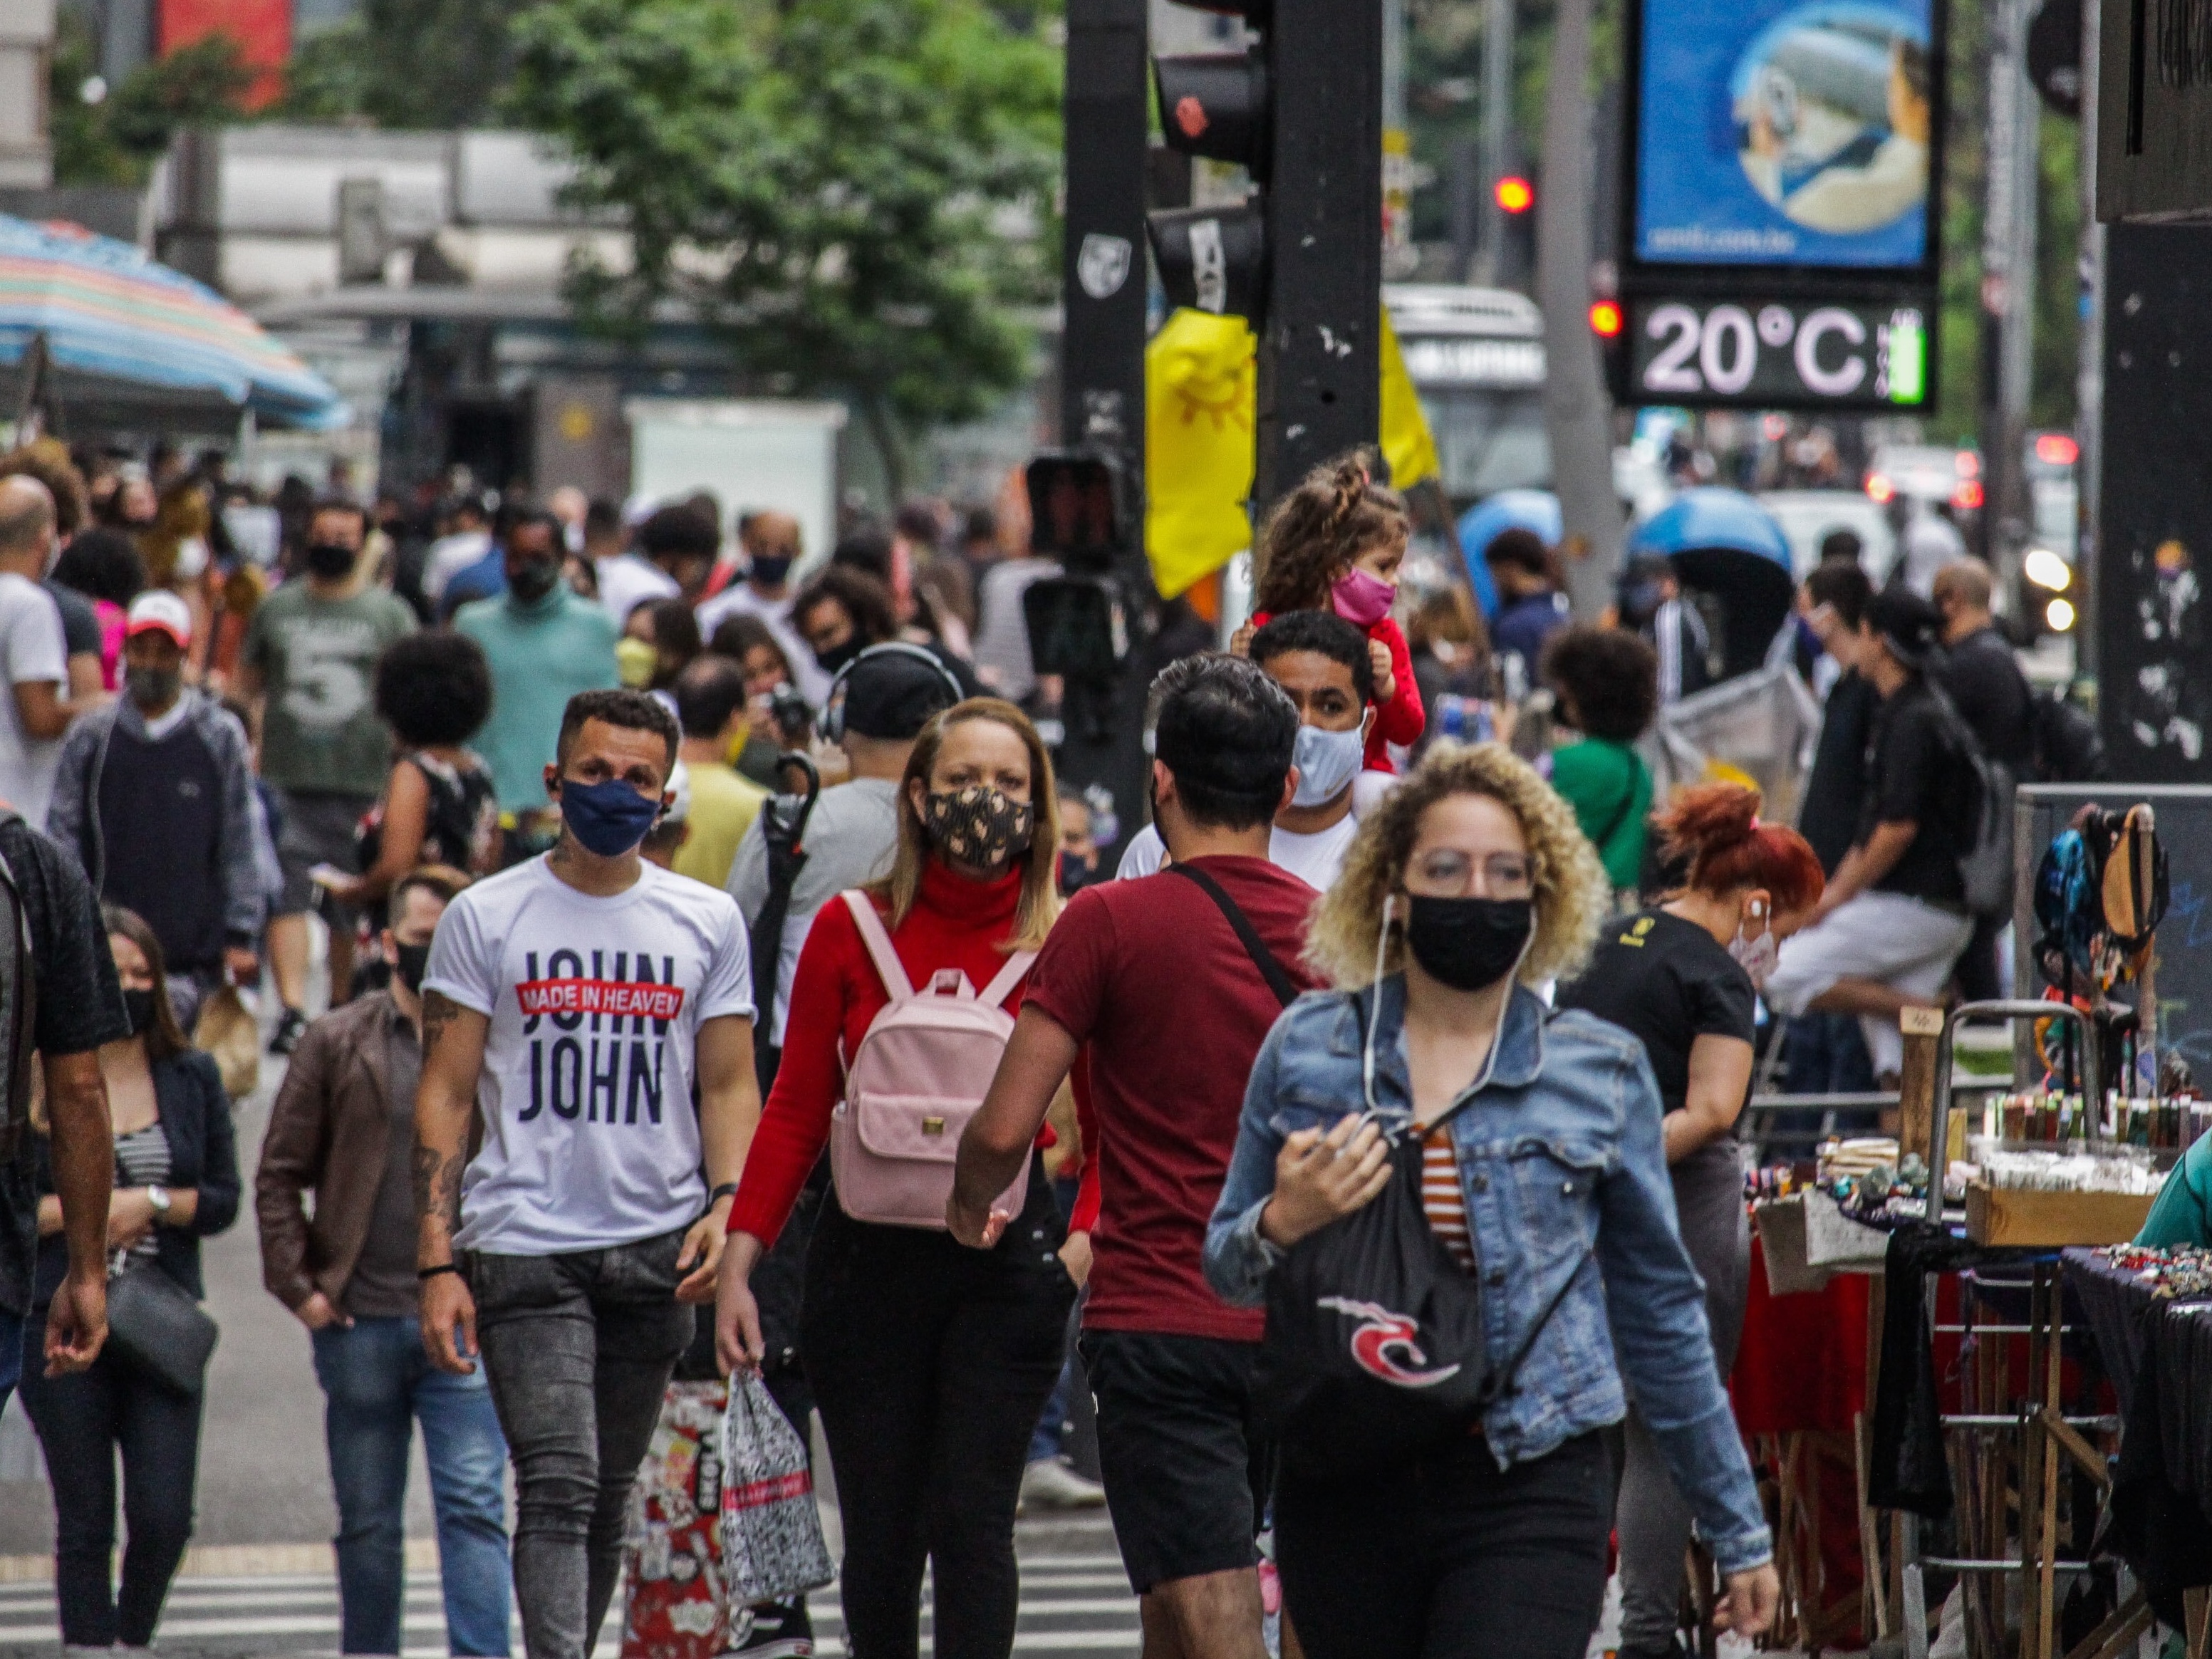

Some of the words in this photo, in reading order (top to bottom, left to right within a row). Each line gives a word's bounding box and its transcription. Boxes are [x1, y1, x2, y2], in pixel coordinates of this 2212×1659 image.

[1644, 303, 1866, 395] 20°C
[286, 635, 368, 726] 5
[523, 985, 578, 1009] MADE
[582, 986, 600, 1009] IN
[603, 989, 680, 1014] HEAVEN
[519, 1037, 663, 1124] JOHN
